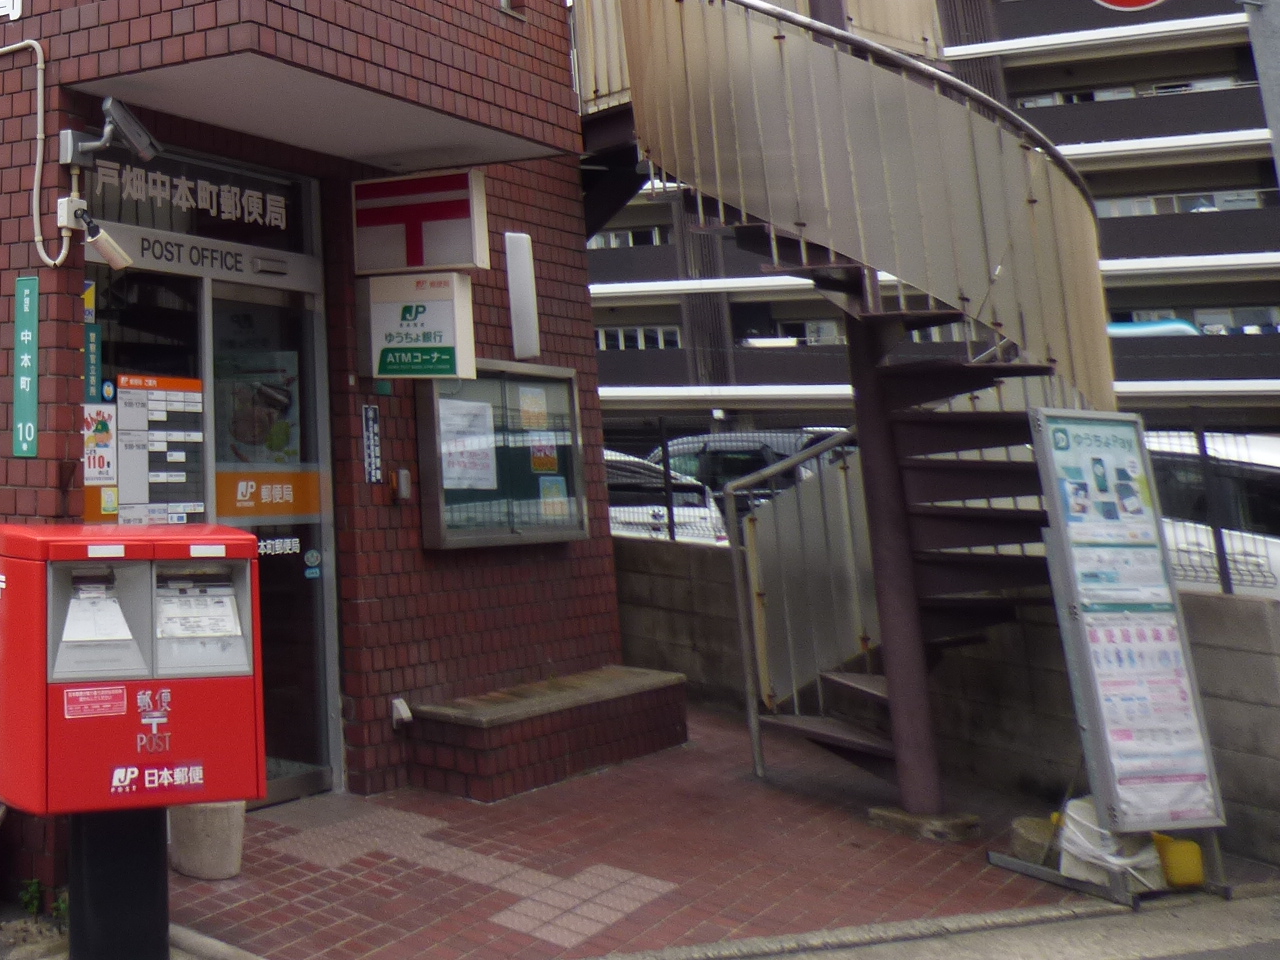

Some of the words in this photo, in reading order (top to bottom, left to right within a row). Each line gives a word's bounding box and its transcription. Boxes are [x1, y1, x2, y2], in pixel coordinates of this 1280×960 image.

[95, 159, 287, 231] 戸畑中本町郵便局
[141, 237, 185, 263] POST
[189, 245, 244, 273] OFFICE
[384, 330, 444, 344] ゆうちょ銀行
[20, 329, 32, 392] 中本町
[386, 352, 450, 363] ATMコーナー
[17, 422, 35, 442] 10
[237, 481, 257, 500] JP
[261, 484, 294, 503] 郵便局
[137, 688, 172, 712] 郵便
[137, 733, 172, 753] POST
[112, 767, 139, 787] JP
[144, 766, 204, 788] 日本郵便
